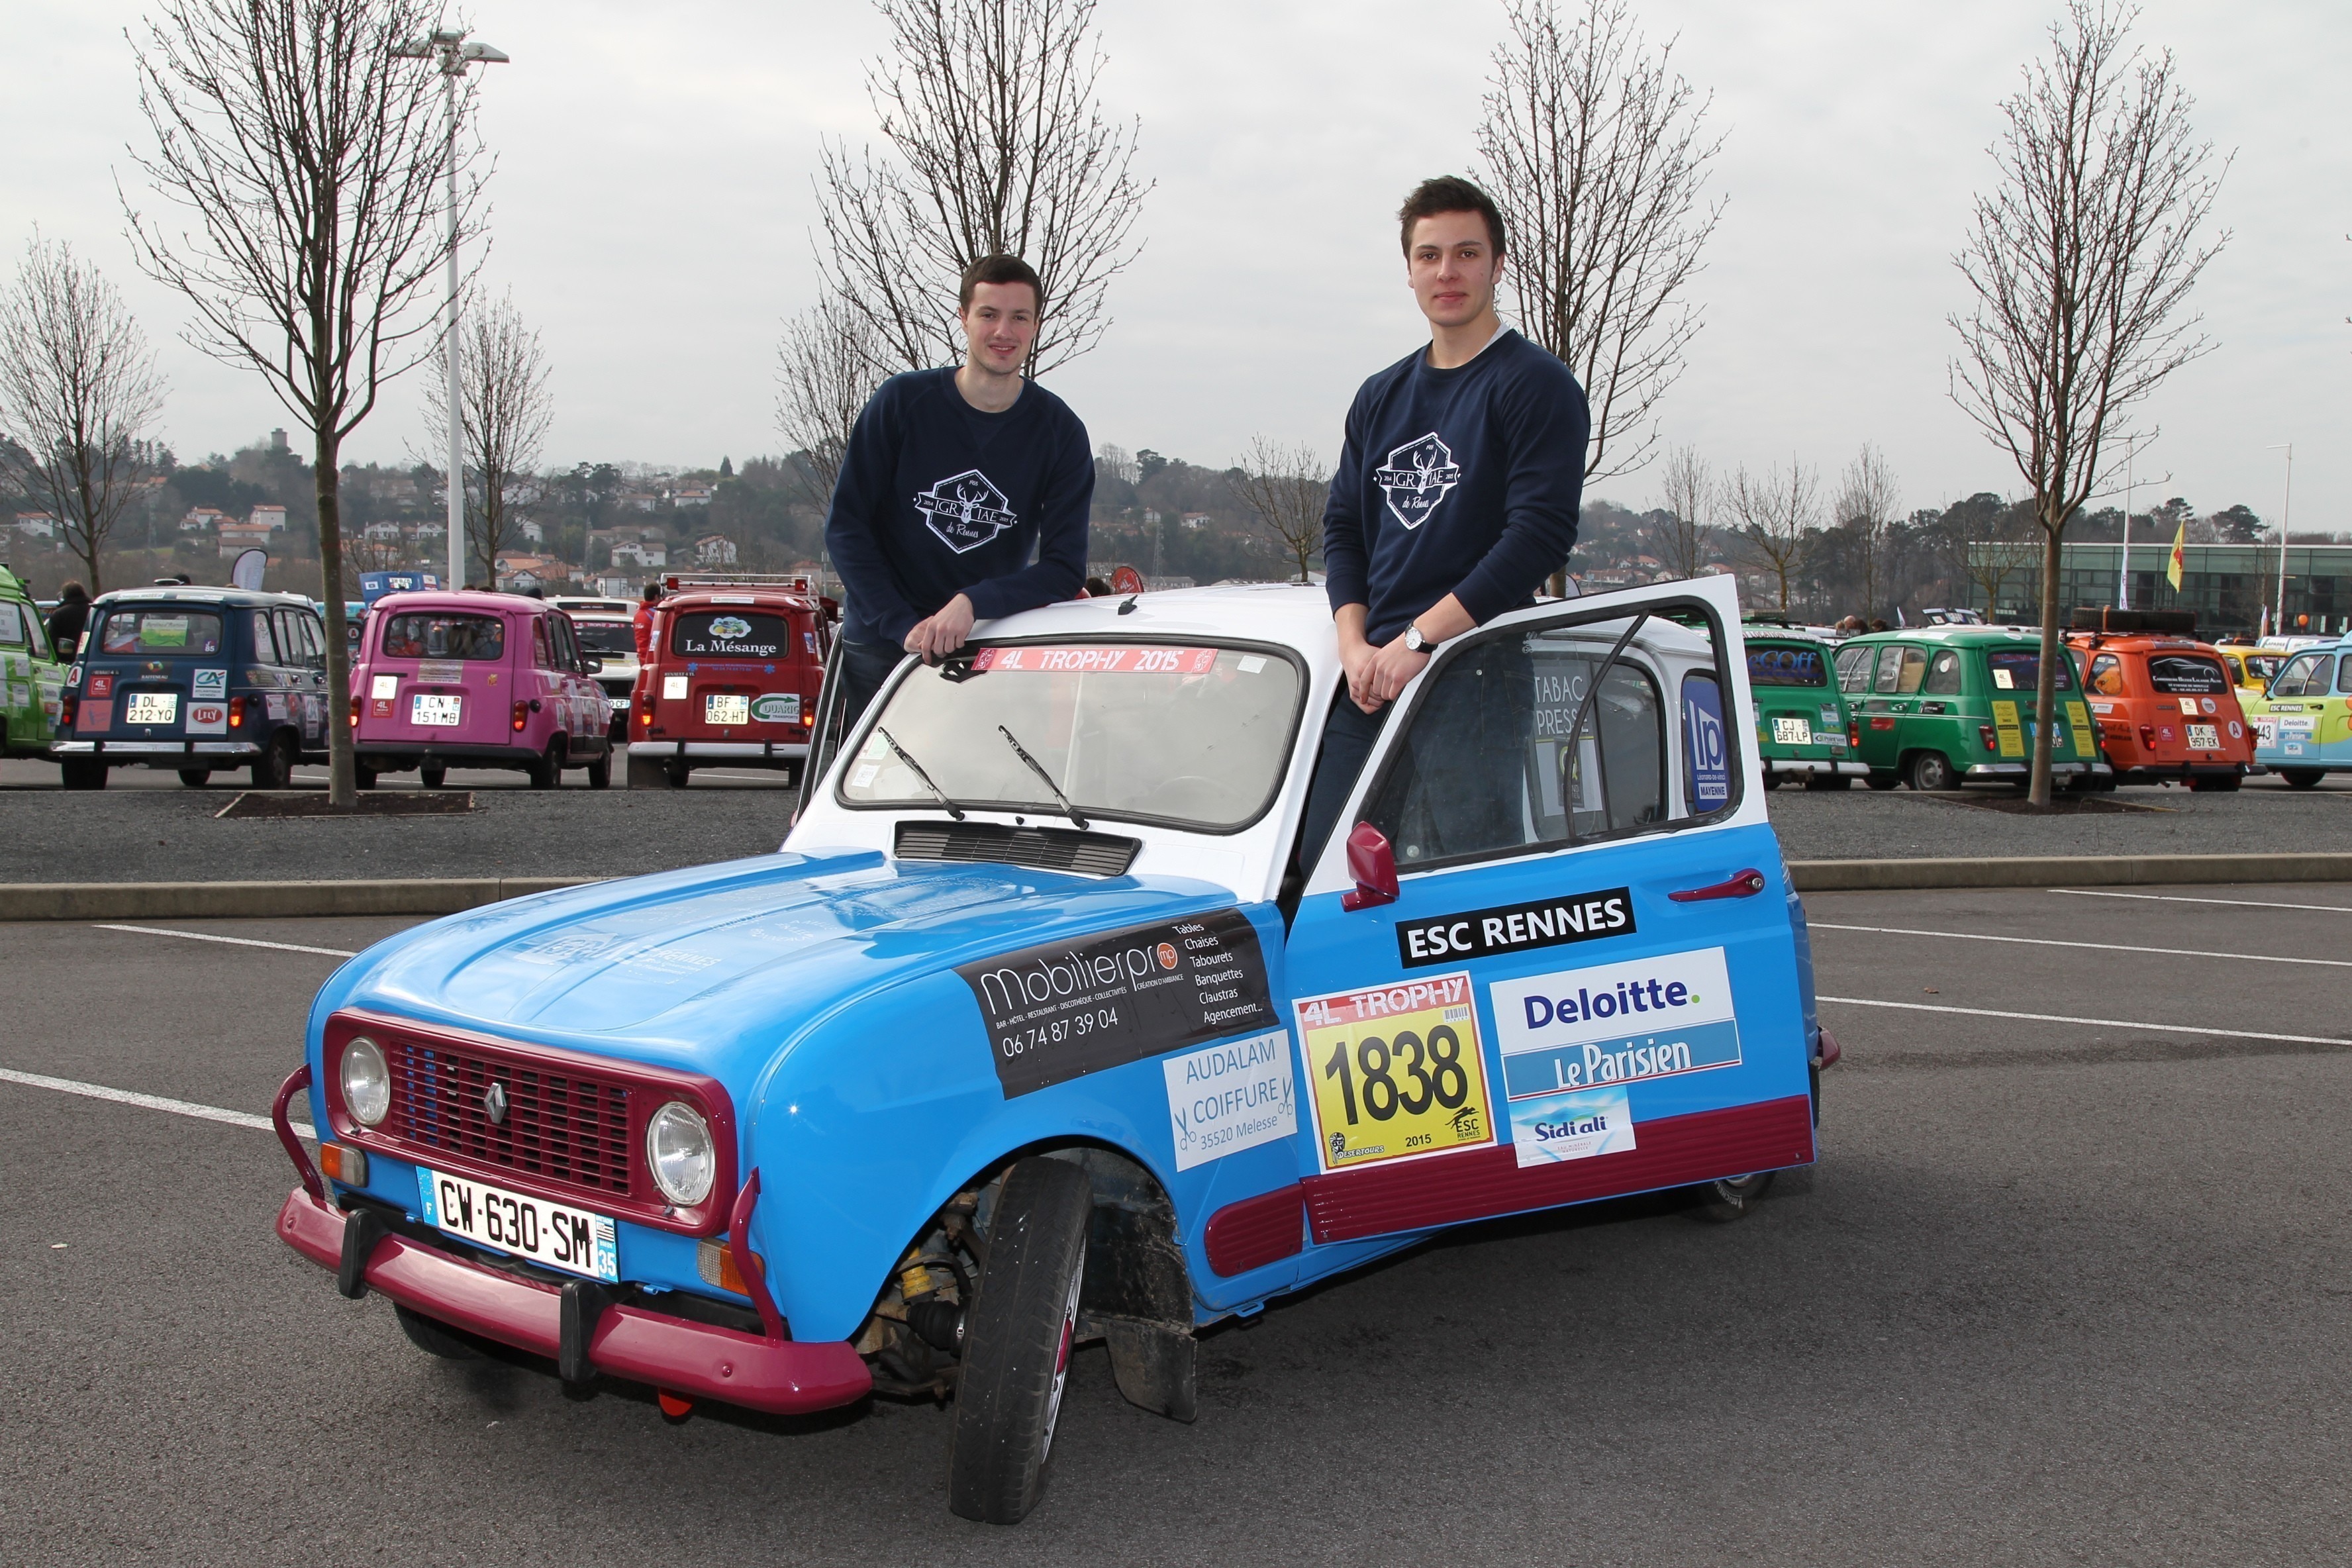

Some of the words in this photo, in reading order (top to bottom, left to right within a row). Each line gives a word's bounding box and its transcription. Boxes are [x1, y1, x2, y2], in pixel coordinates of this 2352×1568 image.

[1393, 472, 1416, 487] IGR
[1429, 470, 1444, 485] IAE
[1402, 495, 1410, 509] de
[1411, 496, 1429, 509] Rennes
[935, 500, 959, 515] IGR
[977, 509, 999, 522] IAE
[946, 522, 954, 534] de
[956, 524, 979, 538] Rennes
[685, 640, 705, 652] La
[710, 640, 777, 656] Mésange
[1000, 650, 1024, 669] 4L
[1039, 650, 1127, 669] TROPHY
[1133, 650, 1184, 670] 2015
[1535, 675, 1584, 703] TABAC
[143, 697, 158, 707] DL
[429, 697, 444, 708] CN
[717, 697, 730, 707] BF
[197, 709, 217, 720] LELY
[1783, 720, 1794, 730] CJ
[2194, 726, 2204, 735] DK
[2232, 723, 2239, 736] A
[1700, 786, 1726, 795] MAYENNE
[1172, 923, 1204, 935] Tables
[1408, 922, 1472, 958] ESC
[1482, 899, 1626, 947] RENNES
[1185, 936, 1218, 950] Chaises
[1189, 952, 1233, 968] Tabourets
[1137, 978, 1157, 990] CRÉATION
[1195, 969, 1244, 986] Banquettes
[1199, 988, 1238, 1004] Claustras
[1304, 1001, 1342, 1026] 4L
[1349, 977, 1464, 1018] TROPHY
[996, 1020, 1007, 1029] BAR
[1028, 1005, 1057, 1019] RESTAURANT
[1003, 1034, 1024, 1057] 06
[1026, 1026, 1048, 1049] 74
[1051, 1020, 1069, 1042] 87
[1075, 1013, 1094, 1035] 39
[1098, 1006, 1118, 1029] 04
[1187, 1038, 1276, 1085] AUDALAM
[1555, 1057, 1581, 1089] Le
[1582, 1038, 1692, 1085] Parisien
[1325, 1024, 1468, 1126] 1838
[1194, 1078, 1278, 1123] COIFFURE
[1200, 1127, 1233, 1150] 35520
[1236, 1116, 1277, 1138] Melesse
[1456, 1118, 1479, 1133] ESC
[1534, 1120, 1577, 1142] Sidi
[1579, 1116, 1607, 1134] ali
[1405, 1134, 1432, 1148] 2015
[1457, 1130, 1481, 1139] RENNES
[1337, 1146, 1385, 1159] DESERTOURS
[426, 1202, 432, 1216] F
[596, 1214, 614, 1225] BRETAGNE
[599, 1250, 616, 1277] 35
